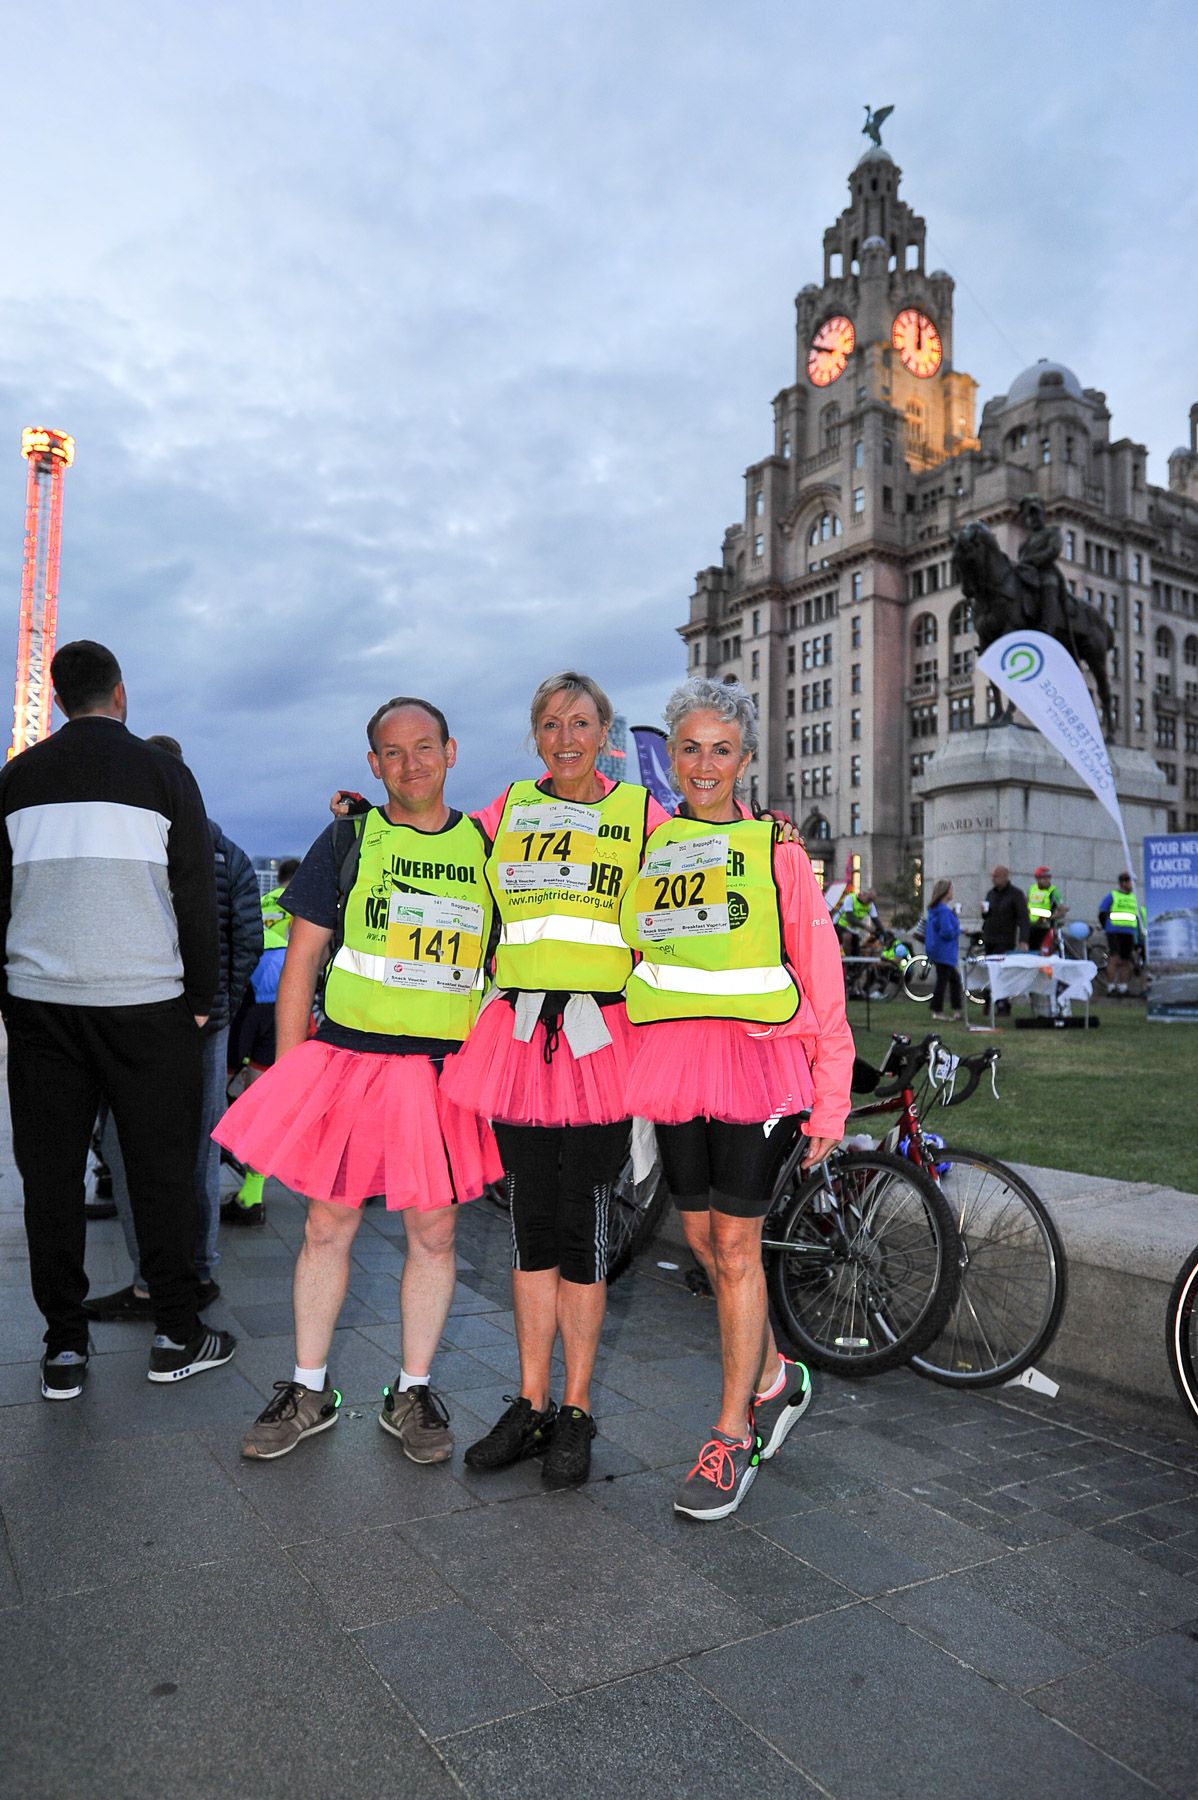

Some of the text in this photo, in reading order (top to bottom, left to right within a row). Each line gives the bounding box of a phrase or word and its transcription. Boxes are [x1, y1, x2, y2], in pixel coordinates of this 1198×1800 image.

[520, 831, 572, 862] 174
[598, 824, 632, 843] OOL
[726, 848, 745, 877] ER
[1150, 841, 1179, 856] YOUR
[391, 854, 477, 884] LIVERPOOL
[588, 861, 624, 898] DER
[1150, 858, 1192, 873] CANCER
[654, 872, 706, 911] 202
[1150, 874, 1198, 890] HOSPITAL
[409, 927, 461, 965] 141
